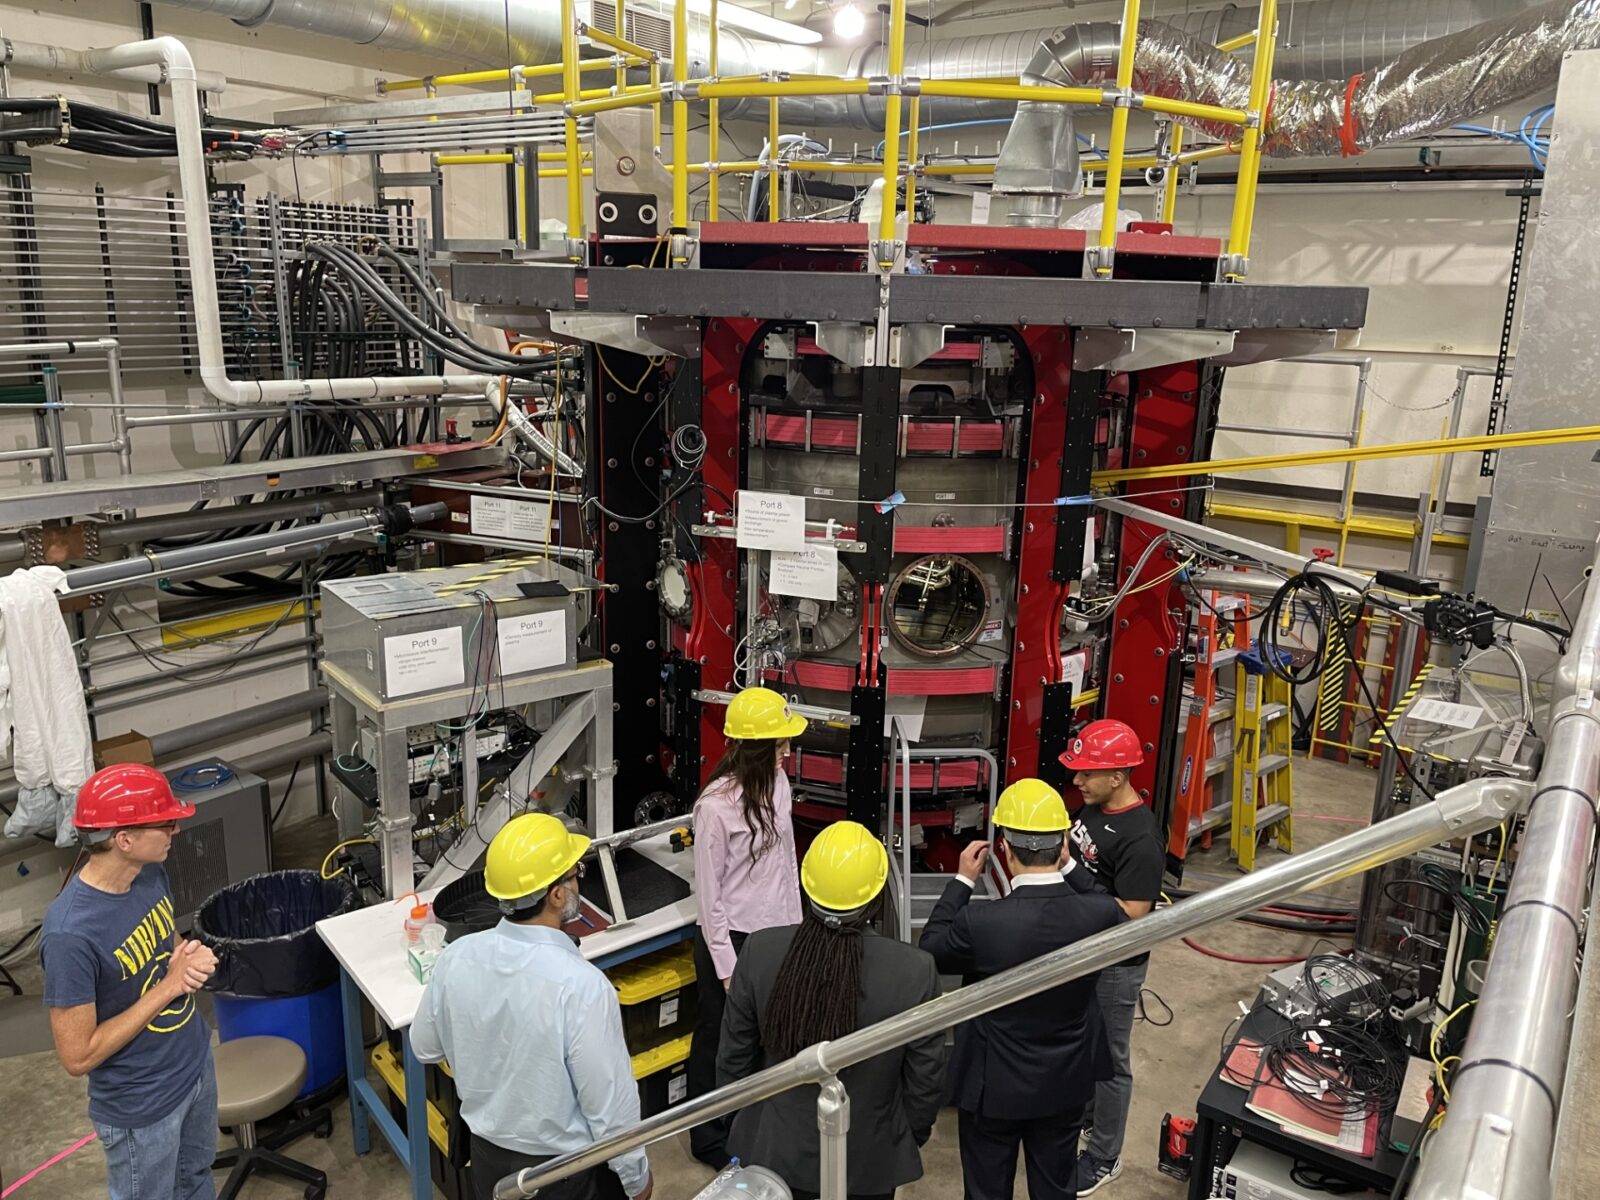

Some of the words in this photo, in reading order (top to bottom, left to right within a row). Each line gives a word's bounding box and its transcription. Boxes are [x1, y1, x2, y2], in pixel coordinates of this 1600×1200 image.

[760, 500, 775, 509] Port
[777, 501, 783, 509] 8
[520, 620, 536, 631] Port
[538, 619, 543, 628] 9
[412, 638, 430, 649] Port
[431, 637, 437, 646] 9
